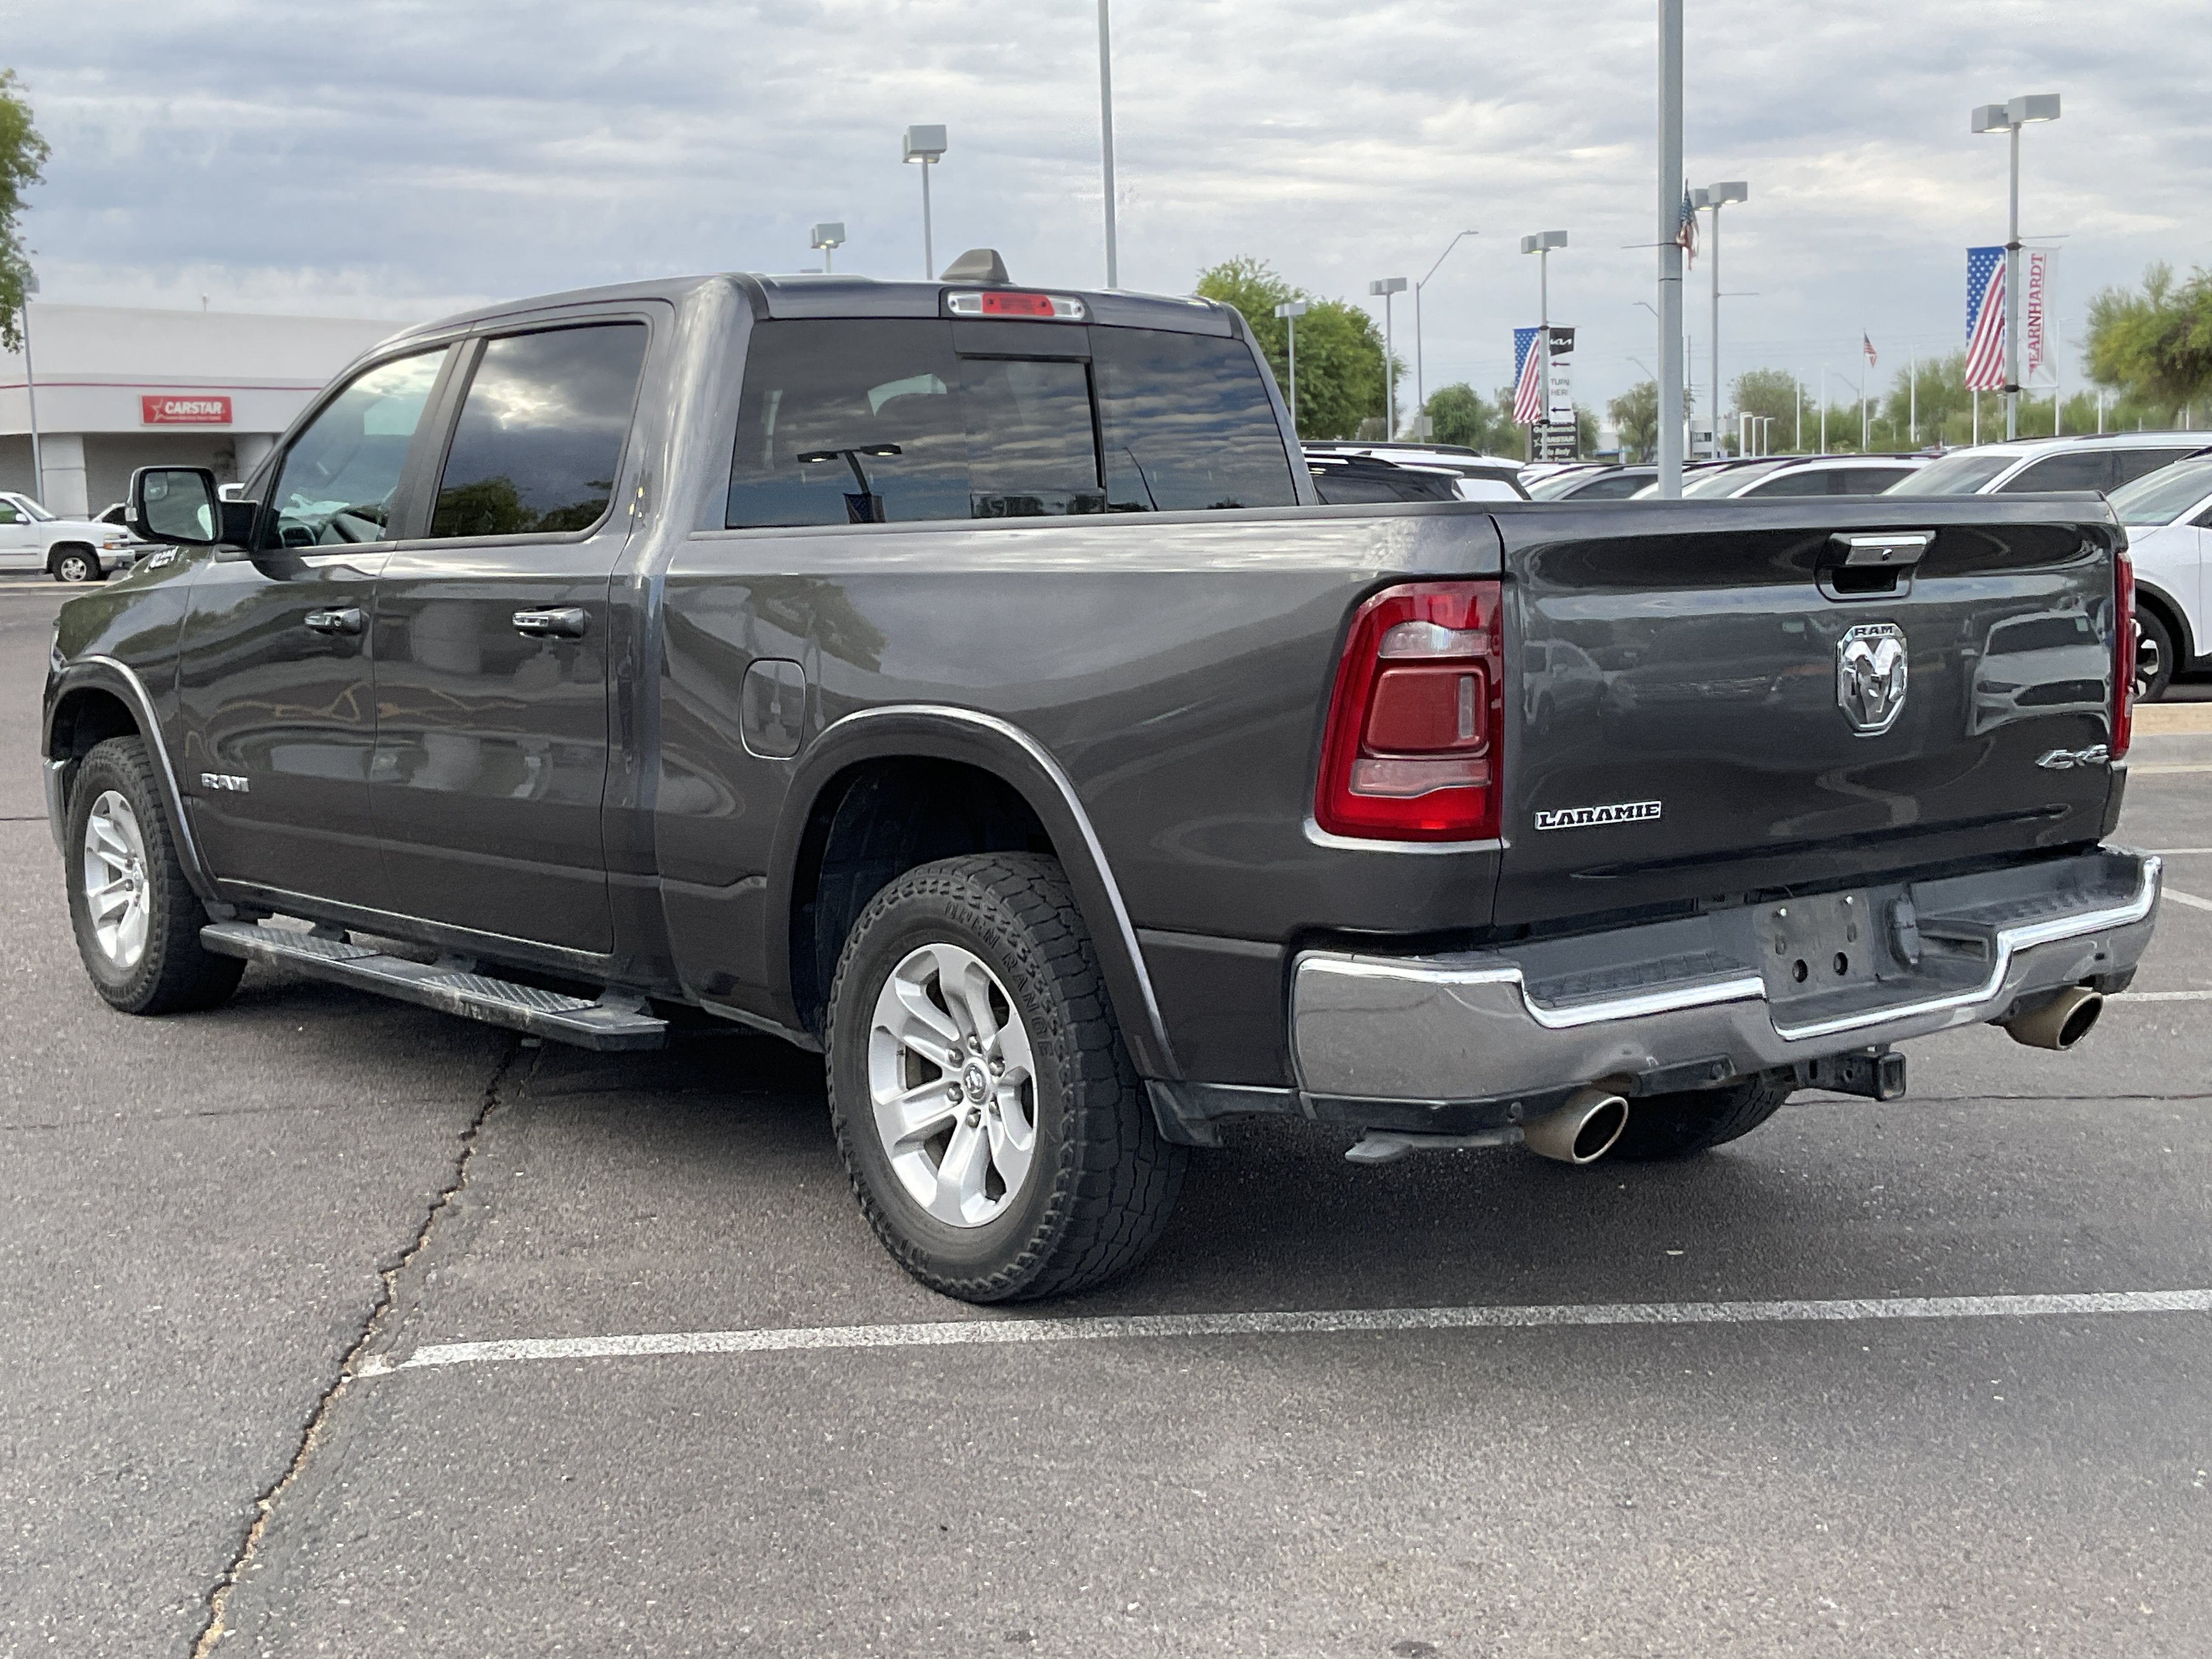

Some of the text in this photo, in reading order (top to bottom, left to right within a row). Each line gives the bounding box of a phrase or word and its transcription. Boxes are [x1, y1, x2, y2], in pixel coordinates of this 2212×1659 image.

[2028, 253, 2043, 363] EARNHARDT
[165, 401, 222, 414] CARSTAR
[1854, 626, 1893, 636] RAM
[201, 772, 250, 792] RAM
[1536, 801, 1662, 830] LARAMIE
